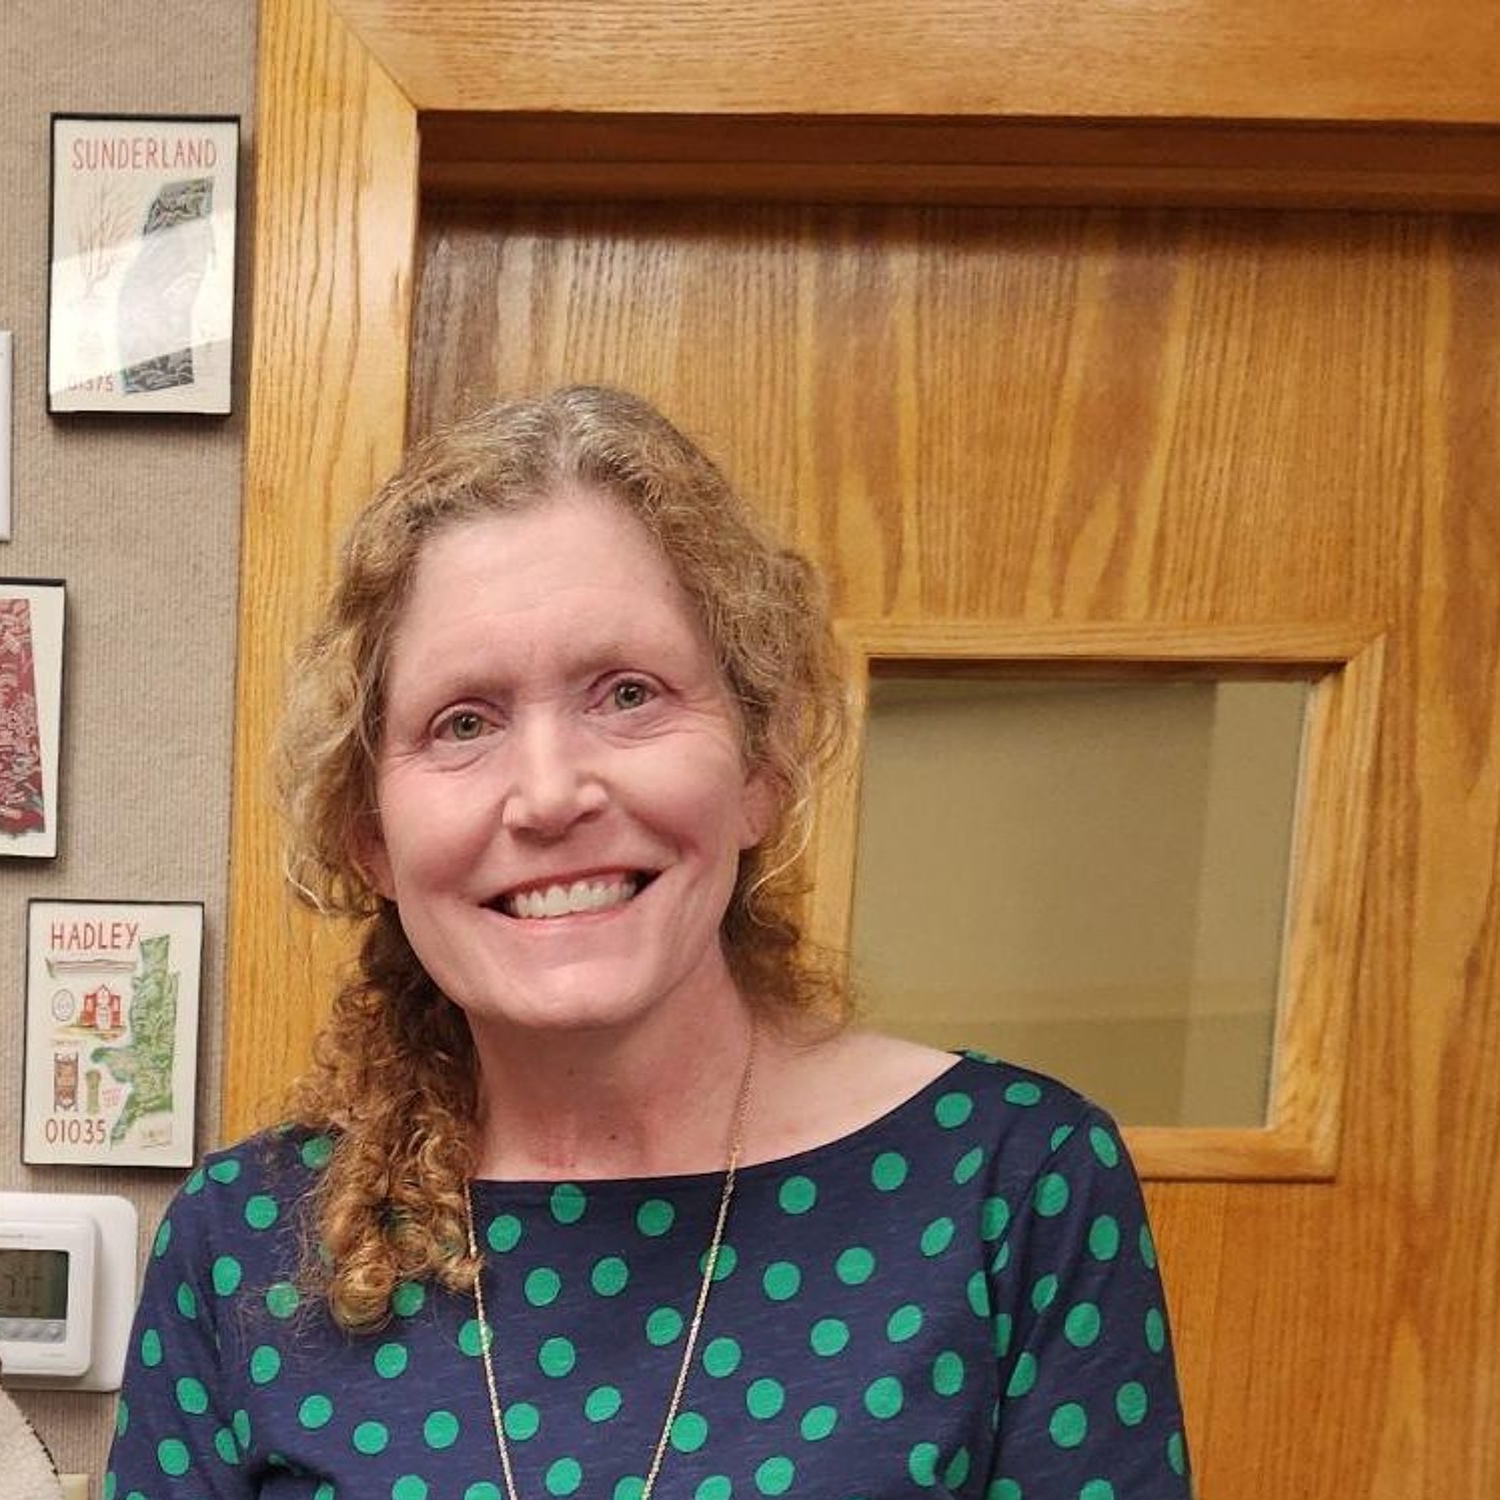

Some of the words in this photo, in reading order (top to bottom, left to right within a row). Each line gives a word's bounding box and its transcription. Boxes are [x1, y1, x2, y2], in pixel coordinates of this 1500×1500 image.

[72, 138, 217, 171] SUNDERLAND
[51, 922, 140, 951] HADLEY
[45, 1119, 106, 1144] 01035
